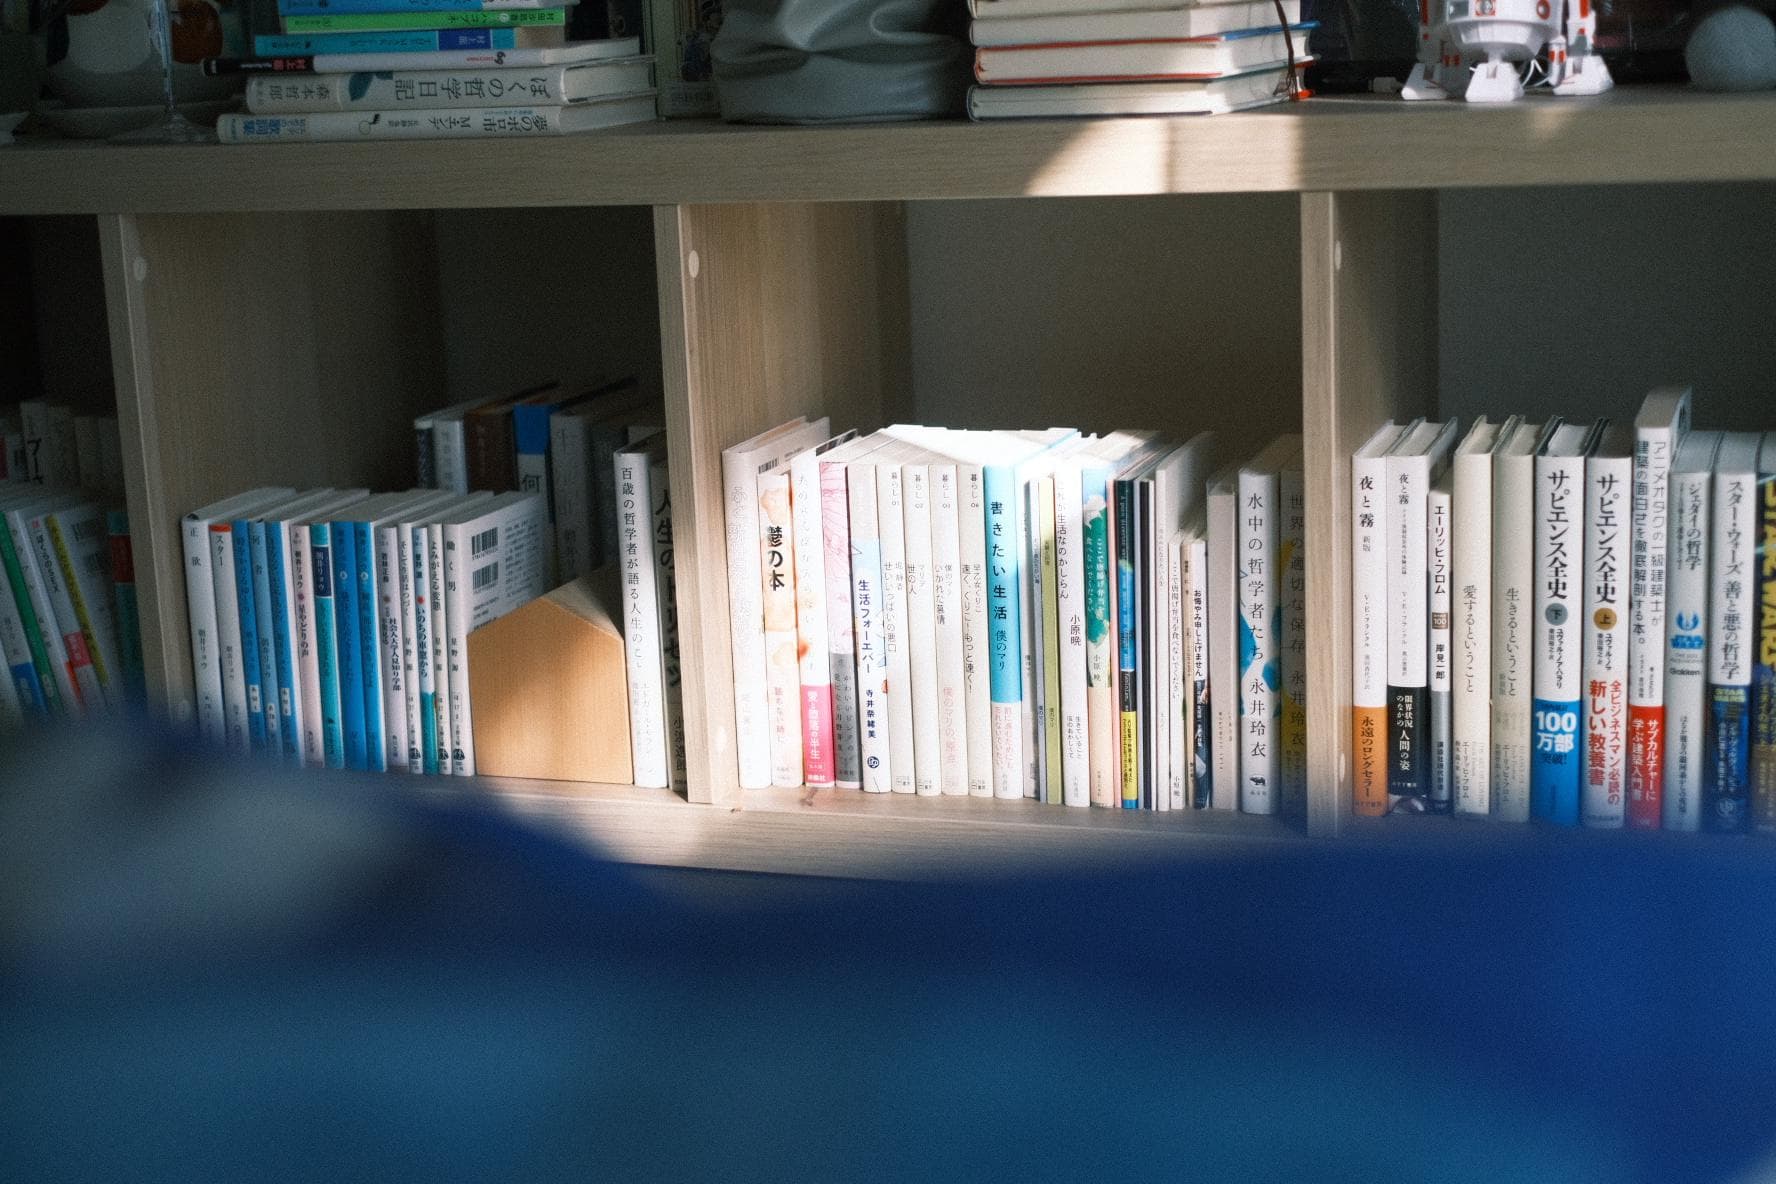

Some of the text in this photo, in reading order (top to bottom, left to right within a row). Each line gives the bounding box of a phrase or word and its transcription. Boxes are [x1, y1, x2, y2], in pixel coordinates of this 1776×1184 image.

[395, 77, 553, 106] ぼくの哲学日記
[483, 114, 549, 135] 夢のボロ市
[1359, 474, 1375, 529] 夜と霧
[1398, 472, 1410, 506] 夜と霧
[1686, 482, 1704, 571] ジェダイの哲学
[215, 534, 225, 568] スター
[620, 465, 646, 671] 百歳の哲学者が語る人生のこと
[768, 525, 786, 592] 鬱の本
[1434, 505, 1446, 595] エーリッヒ・フロム
[1545, 468, 1570, 600] サピエンス全史
[1594, 473, 1619, 605] サピエンス全史
[1633, 439, 1649, 645] 建築の面白さを徹底解剖する本。
[1650, 440, 1667, 627] アニメオタクの一級建築士が
[907, 562, 918, 596] 世の人
[990, 501, 1008, 672] 書きたい生活 僕のマリ
[858, 579, 875, 674] 生活フォーエバー
[1070, 614, 1082, 647] 小原晩
[1247, 493, 1267, 758] 水中の哲学者たち 永井玲衣
[1433, 617, 1448, 626] 100
[1436, 643, 1446, 681] 岸見一郎
[1462, 584, 1477, 694] 愛するということ
[1504, 587, 1520, 698] 生きるということ
[1395, 695, 1405, 728] のなかの
[1399, 730, 1411, 772] 人間の姿
[1404, 694, 1414, 729] 限界状況
[1536, 710, 1577, 732] 100
[1536, 732, 1576, 754] 万部
[1587, 680, 1607, 787] 新しい教養書
[1607, 680, 1622, 806] 全ビジネスマン必読の
[1360, 716, 1374, 798] 永遠のロングセラー
[1645, 719, 1659, 801] サブカルチャーに
